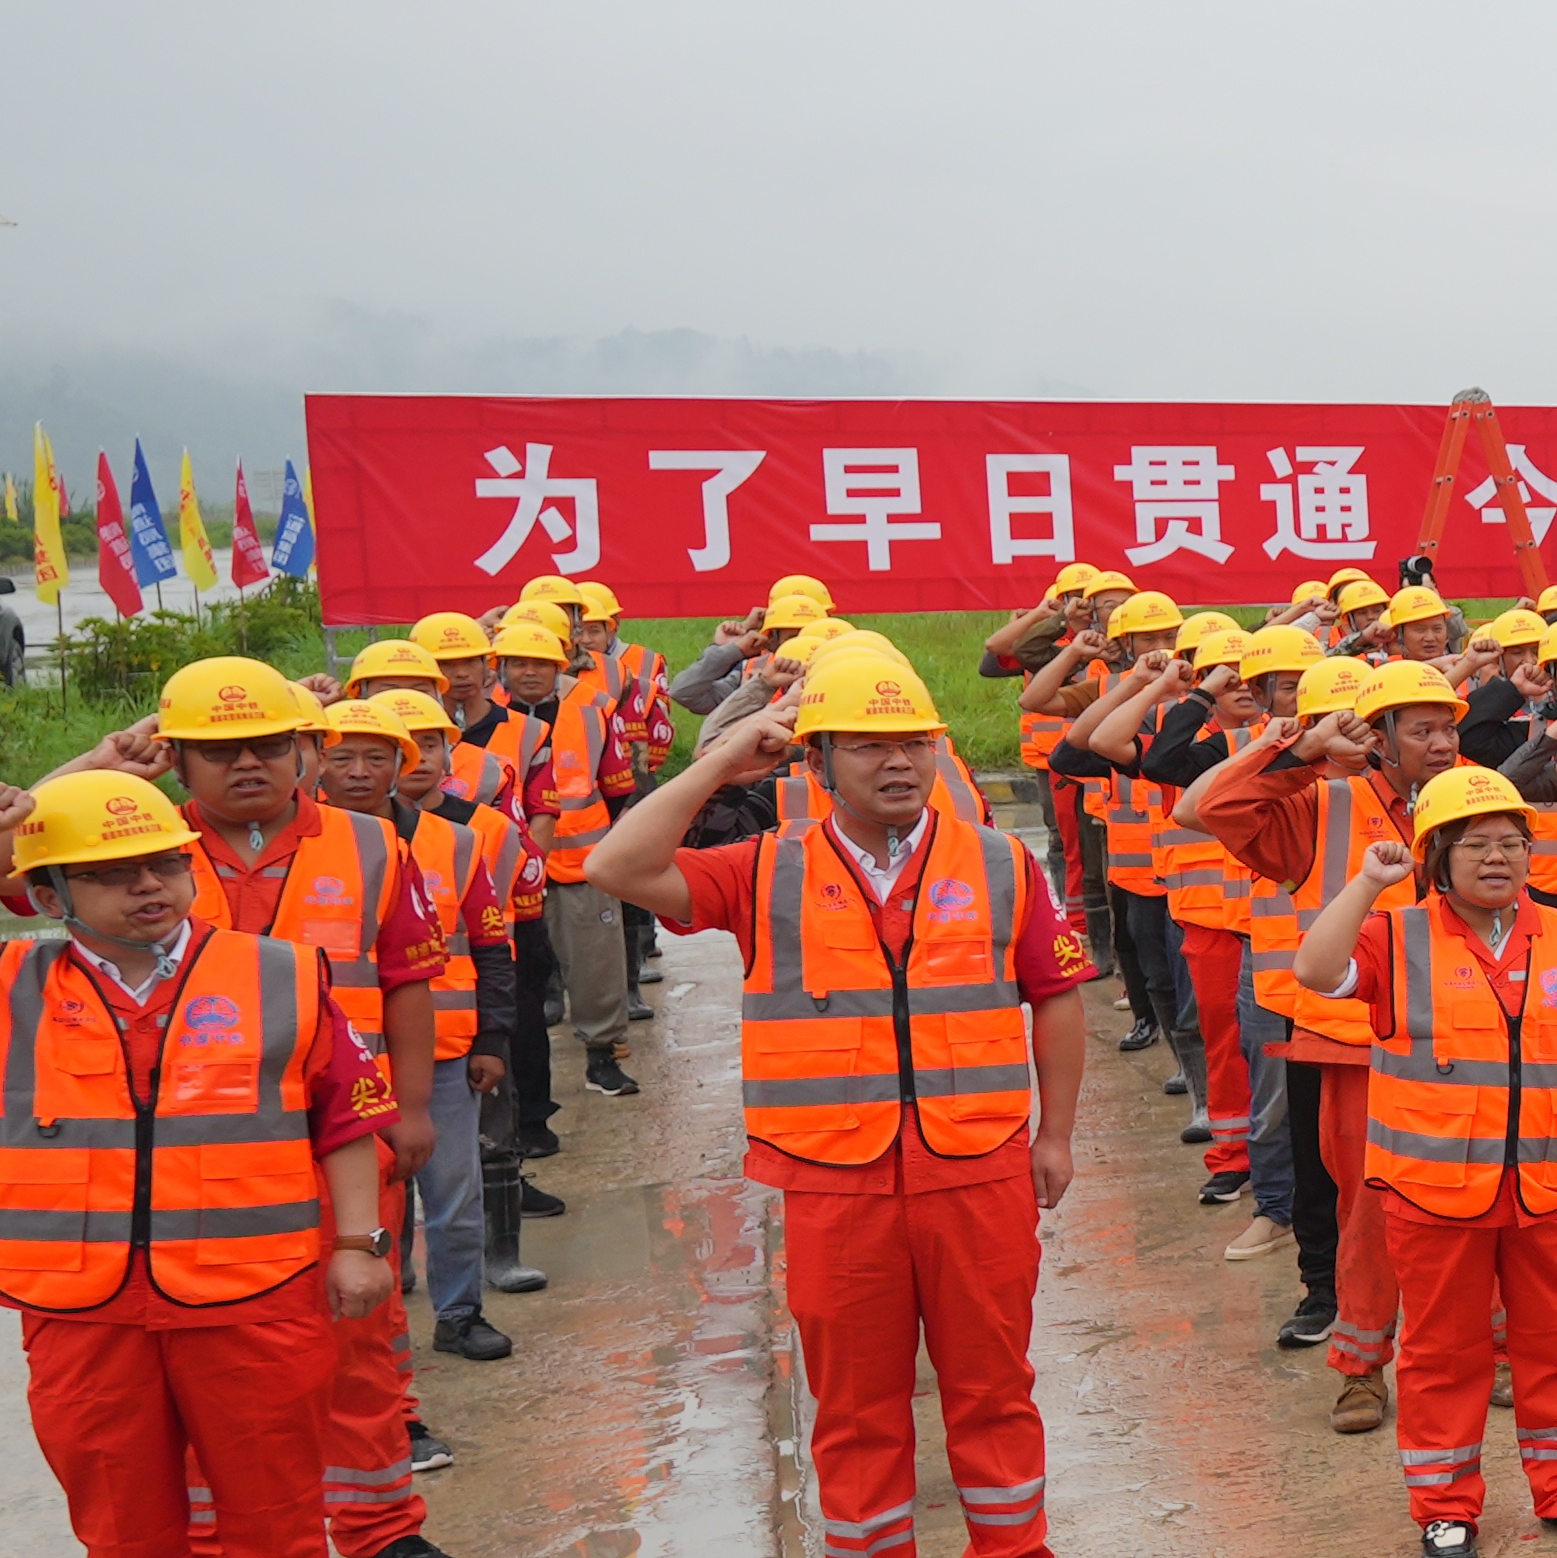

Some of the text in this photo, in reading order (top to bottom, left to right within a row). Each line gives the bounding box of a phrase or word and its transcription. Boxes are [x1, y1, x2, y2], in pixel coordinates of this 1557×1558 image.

[474, 442, 1377, 576] 为了早日贯通
